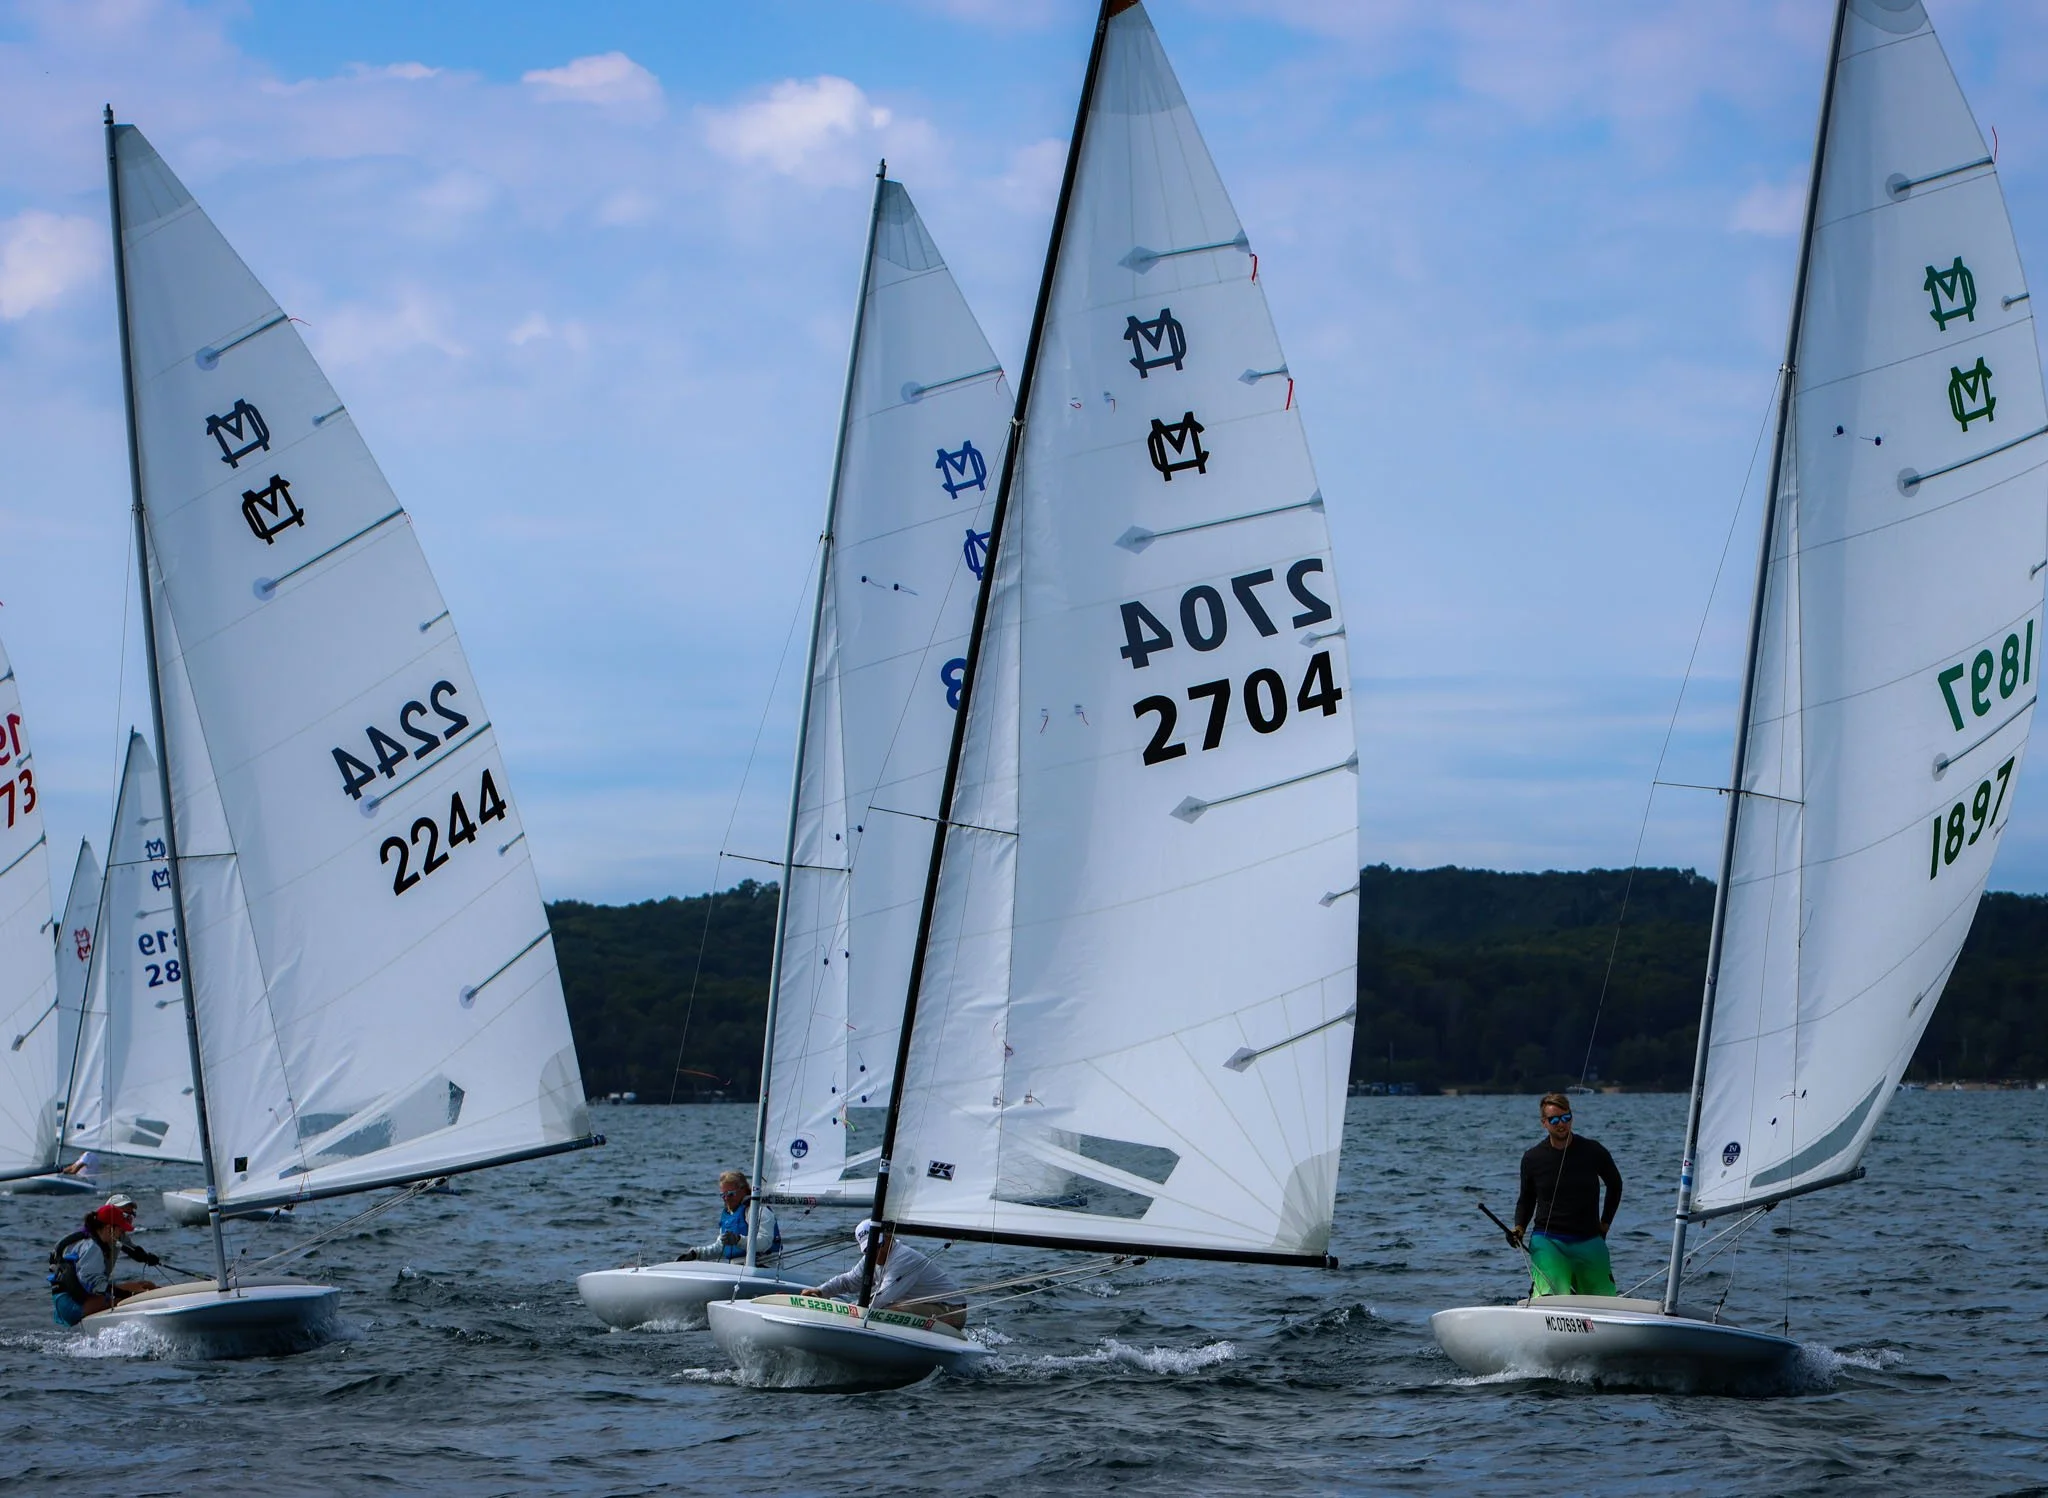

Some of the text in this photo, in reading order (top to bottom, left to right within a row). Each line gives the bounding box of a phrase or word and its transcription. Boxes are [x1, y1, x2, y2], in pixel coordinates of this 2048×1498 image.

[1133, 651, 1342, 766] 2704
[0, 769, 36, 829] 73
[1930, 756, 2015, 880] 1897
[380, 769, 506, 896] 2244
[145, 960, 181, 988] 28
[790, 1296, 805, 1307] MC
[807, 1299, 833, 1311] 5239
[868, 1310, 884, 1320] MC
[884, 1313, 911, 1325] 5239
[1545, 1316, 1557, 1331] MC
[1557, 1317, 1577, 1332] 0769
